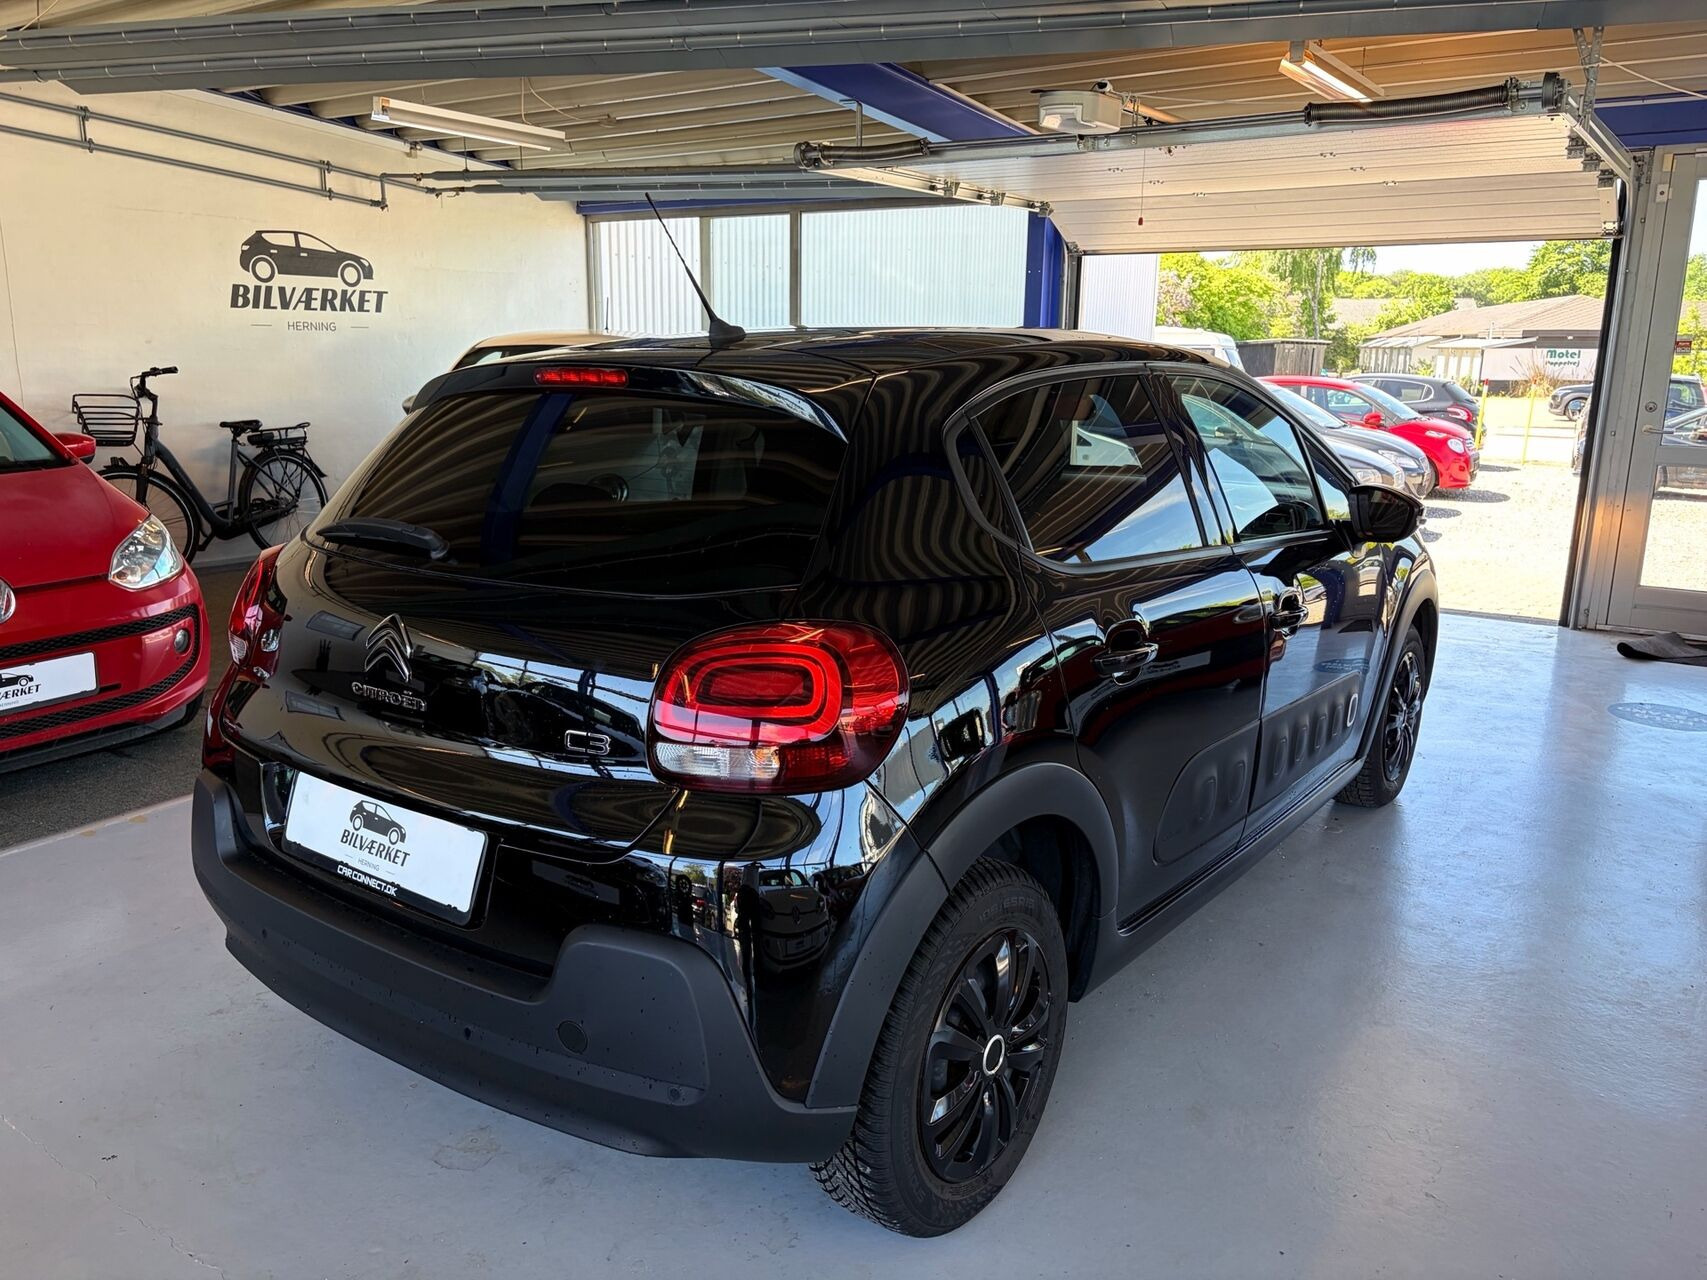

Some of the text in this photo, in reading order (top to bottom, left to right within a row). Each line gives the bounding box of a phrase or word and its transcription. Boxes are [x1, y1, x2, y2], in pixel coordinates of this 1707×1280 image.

[230, 283, 389, 313] BILVÆRKET
[287, 321, 337, 332] HERNING
[1546, 349, 1581, 359] Motel
[0, 683, 42, 700] ÆRKET
[564, 729, 611, 756] C3
[340, 828, 411, 867] BILVÆRKET
[357, 857, 381, 872] HERNING
